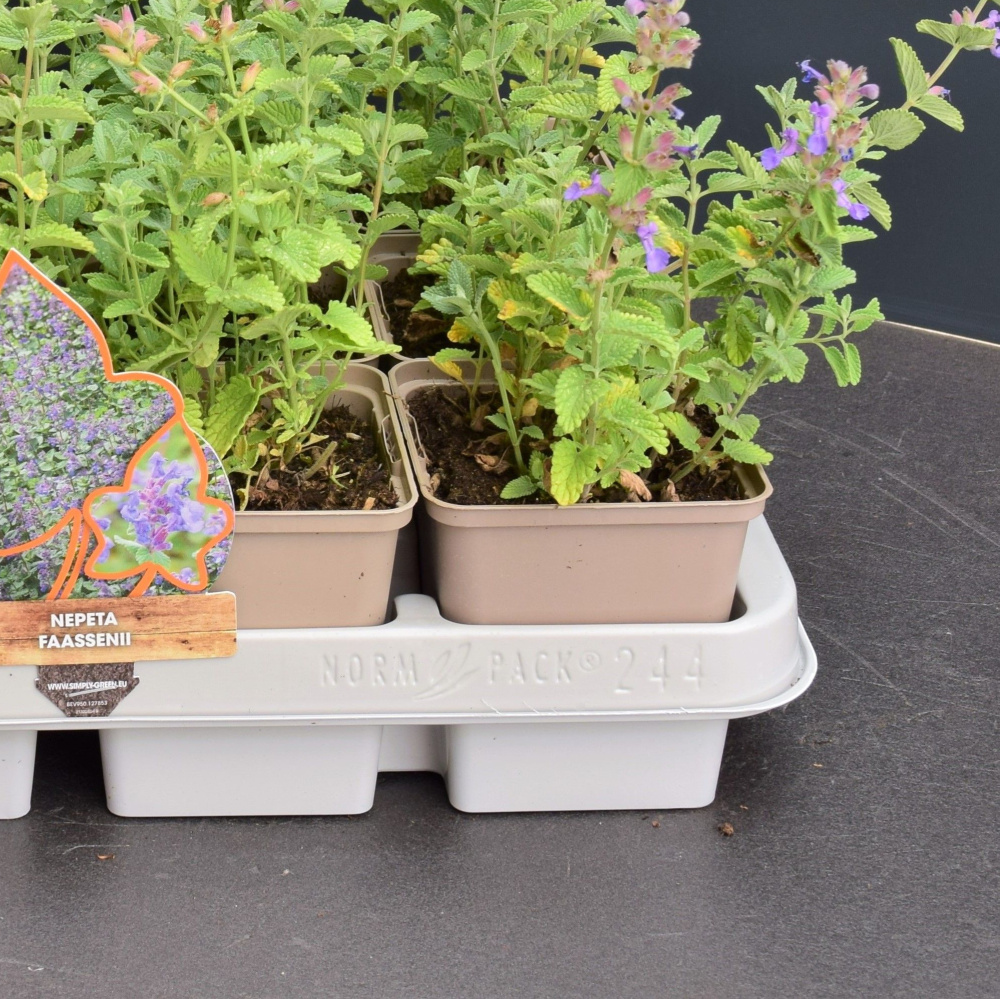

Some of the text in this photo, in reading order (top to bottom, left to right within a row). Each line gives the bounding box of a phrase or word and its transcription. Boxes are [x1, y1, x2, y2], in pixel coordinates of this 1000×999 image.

[50, 612, 118, 627] NEPETA
[38, 632, 131, 649] FAASSENII
[320, 652, 419, 687] NORM
[613, 643, 706, 695] 244
[47, 680, 128, 691] WWW.SIMPLY-GREEN.EU
